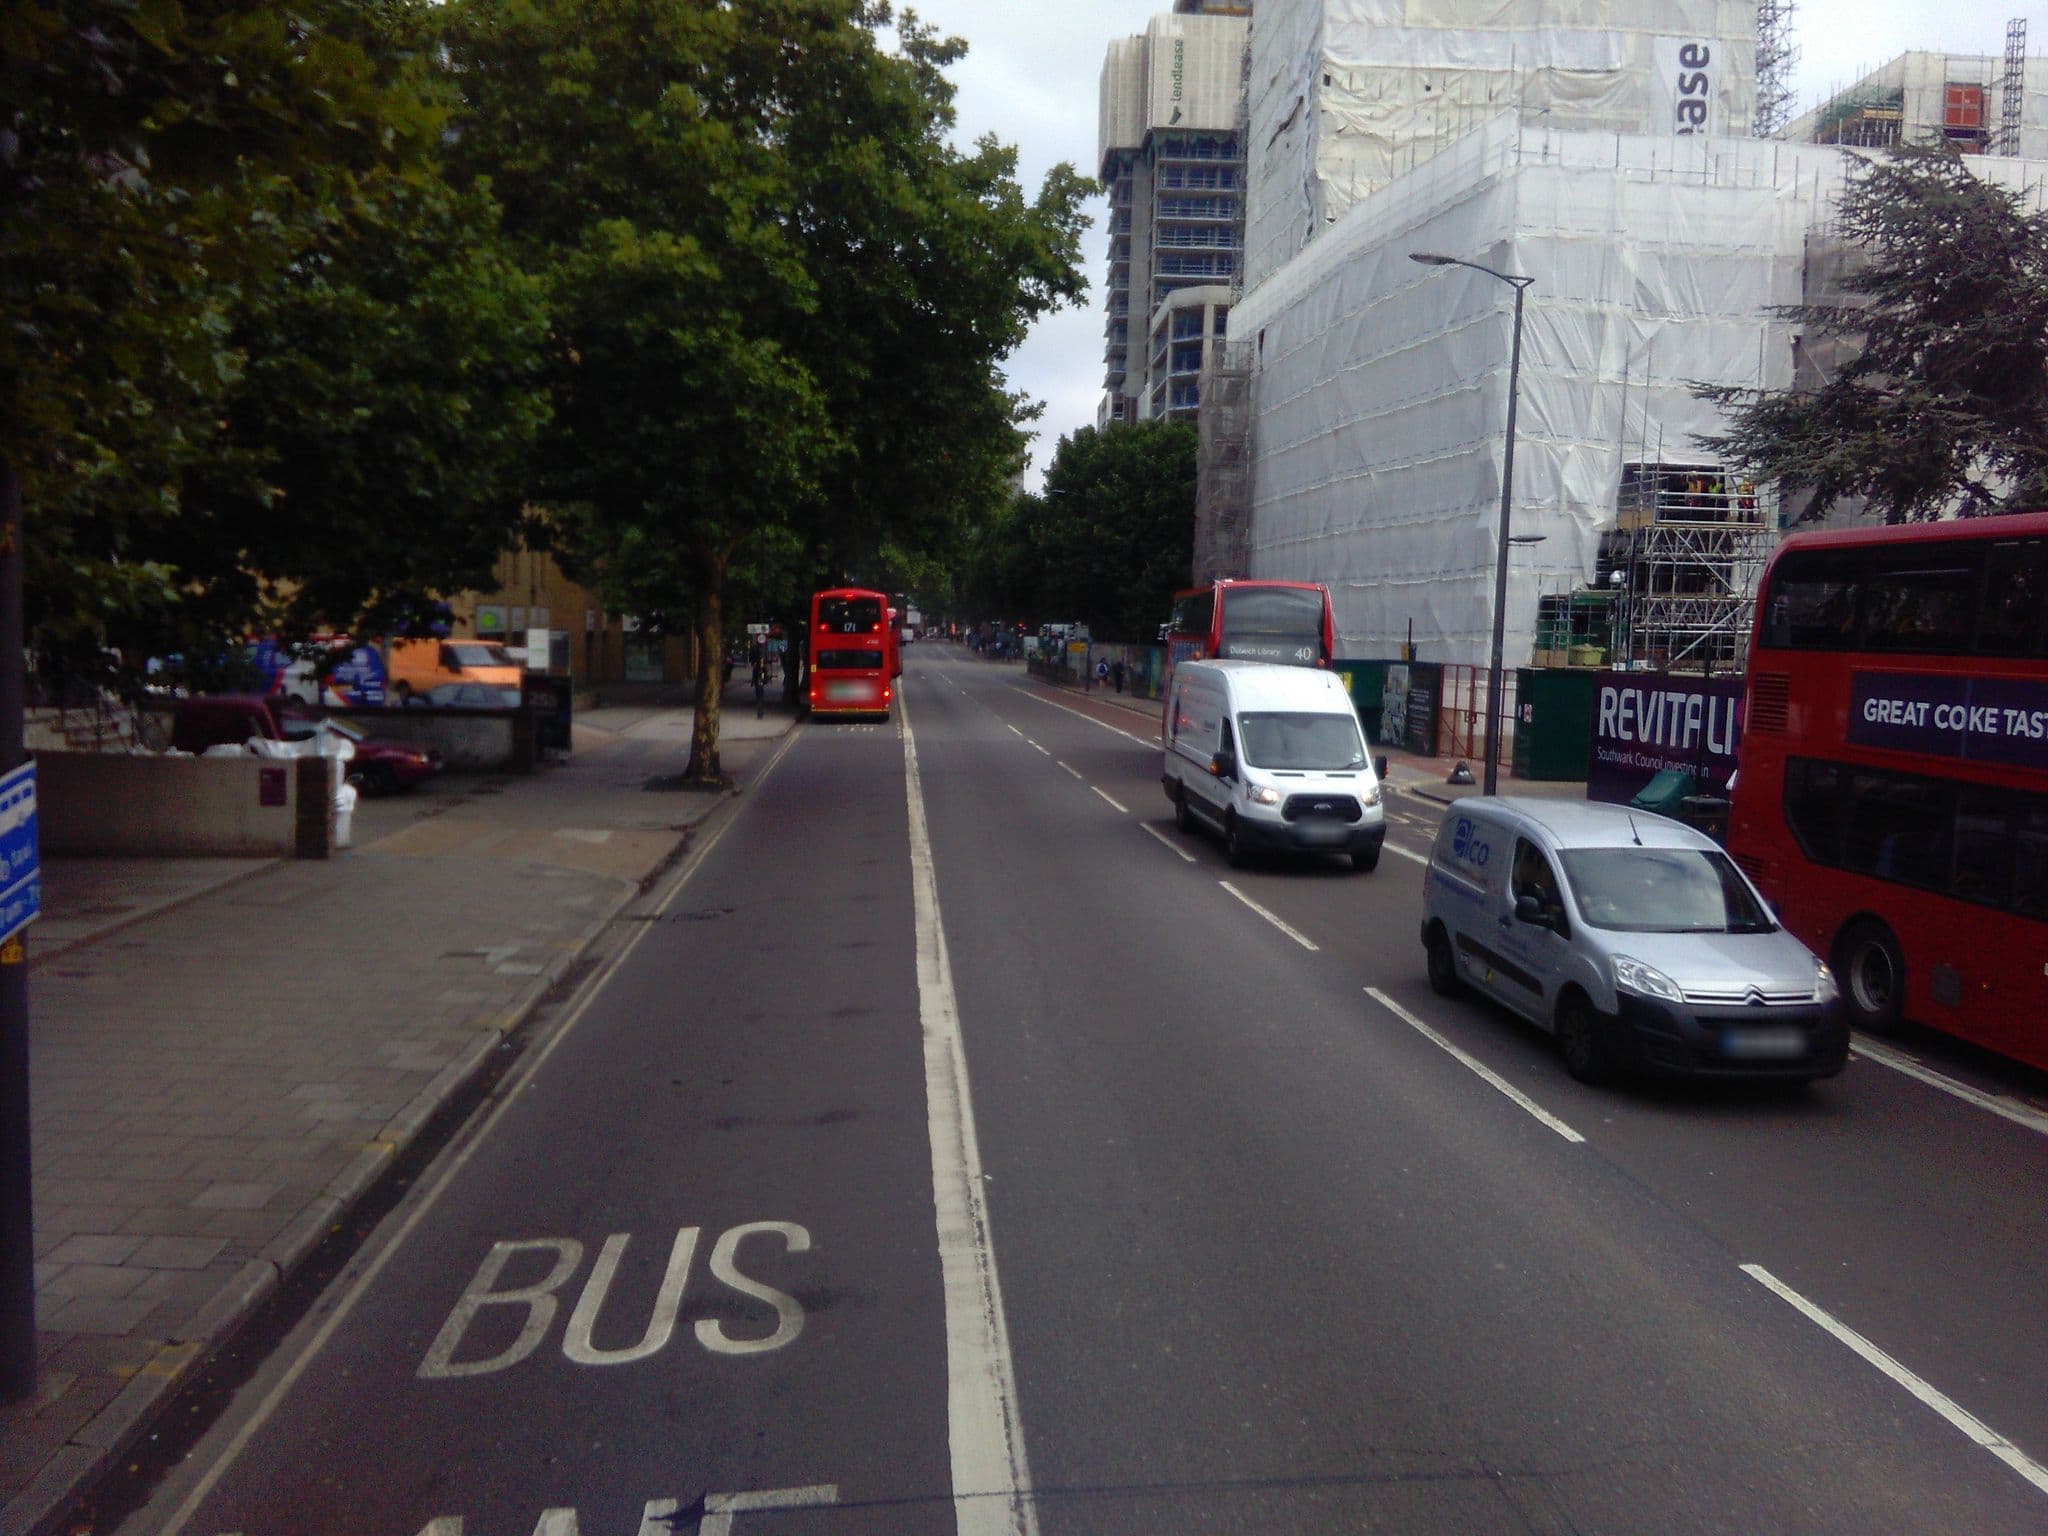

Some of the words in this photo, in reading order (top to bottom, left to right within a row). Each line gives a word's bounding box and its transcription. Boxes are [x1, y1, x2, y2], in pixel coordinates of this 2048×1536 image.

[1170, 39, 1184, 102] lendlease
[1677, 43, 1710, 135] ase
[1257, 646, 1281, 657] Library
[1294, 647, 1313, 661] 40
[1863, 697, 1930, 728] GREAT
[1934, 703, 1999, 734] COKE
[1597, 746, 1633, 765] Southwark
[1635, 752, 1663, 769] Council
[415, 1220, 811, 1381] BUS
